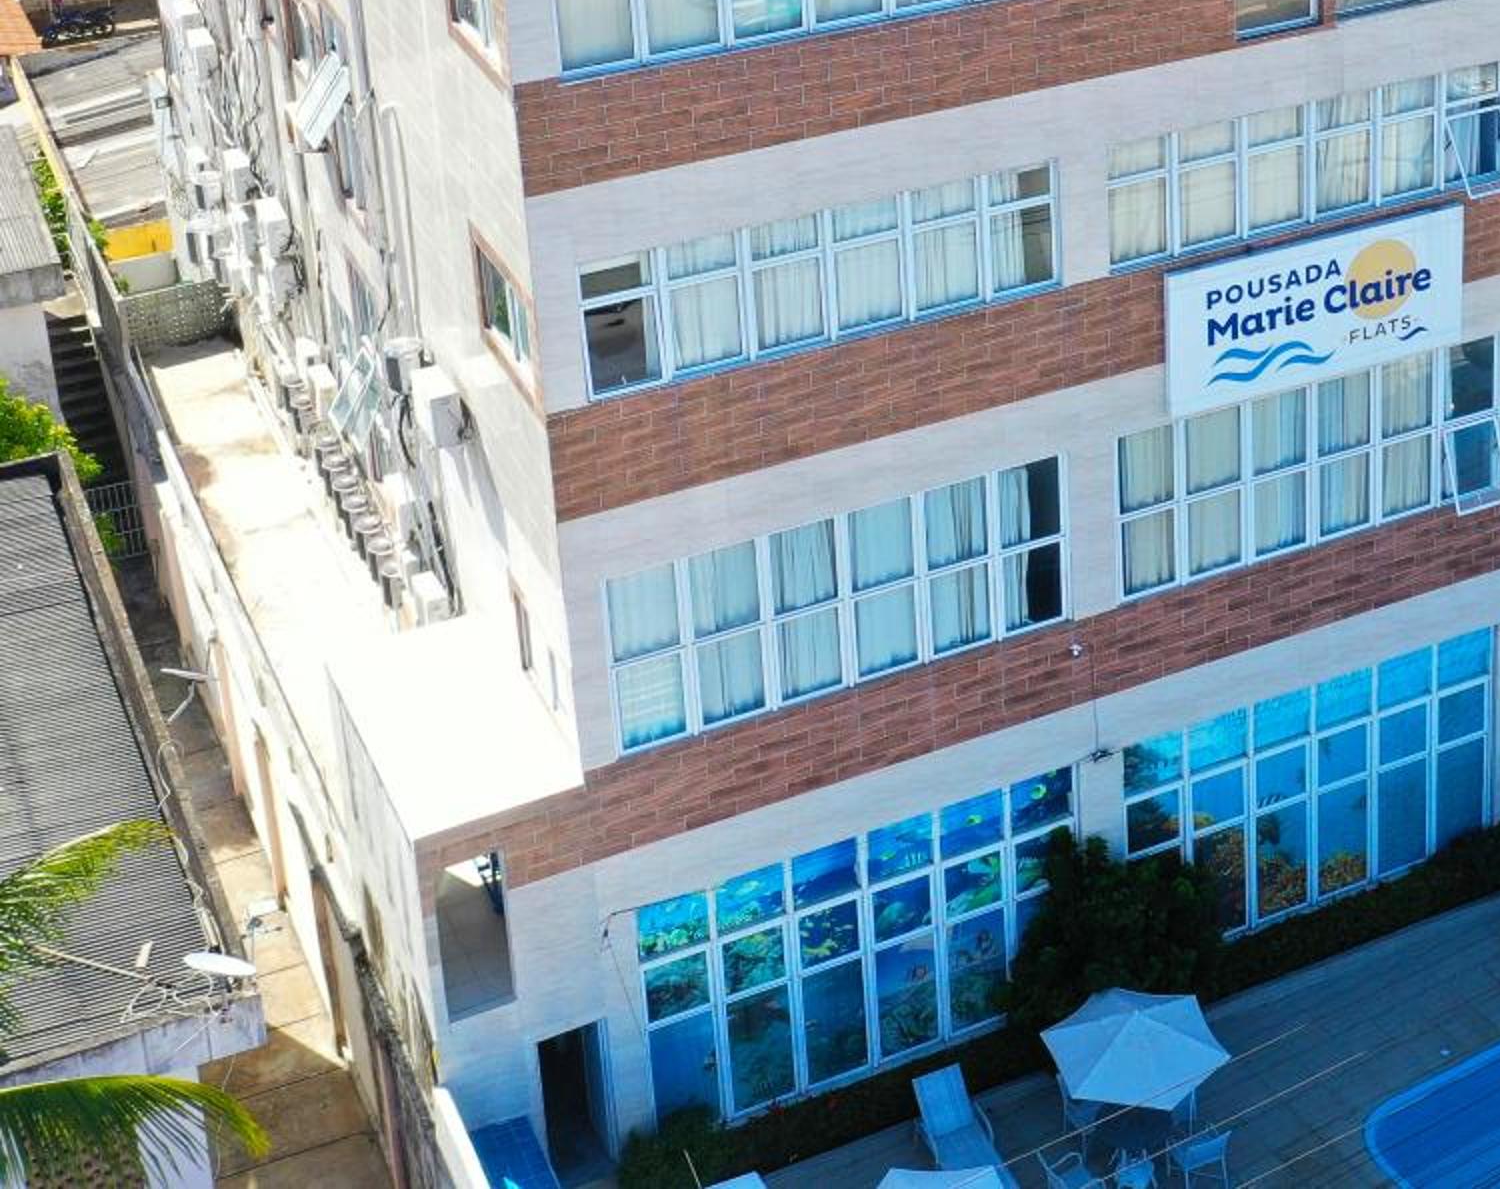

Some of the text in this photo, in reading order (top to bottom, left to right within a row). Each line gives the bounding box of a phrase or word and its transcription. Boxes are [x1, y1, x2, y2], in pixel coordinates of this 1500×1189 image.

[1206, 259, 1342, 310] POUSADA
[1207, 267, 1431, 346] Marie Claire
[1349, 314, 1411, 345] FLATS
